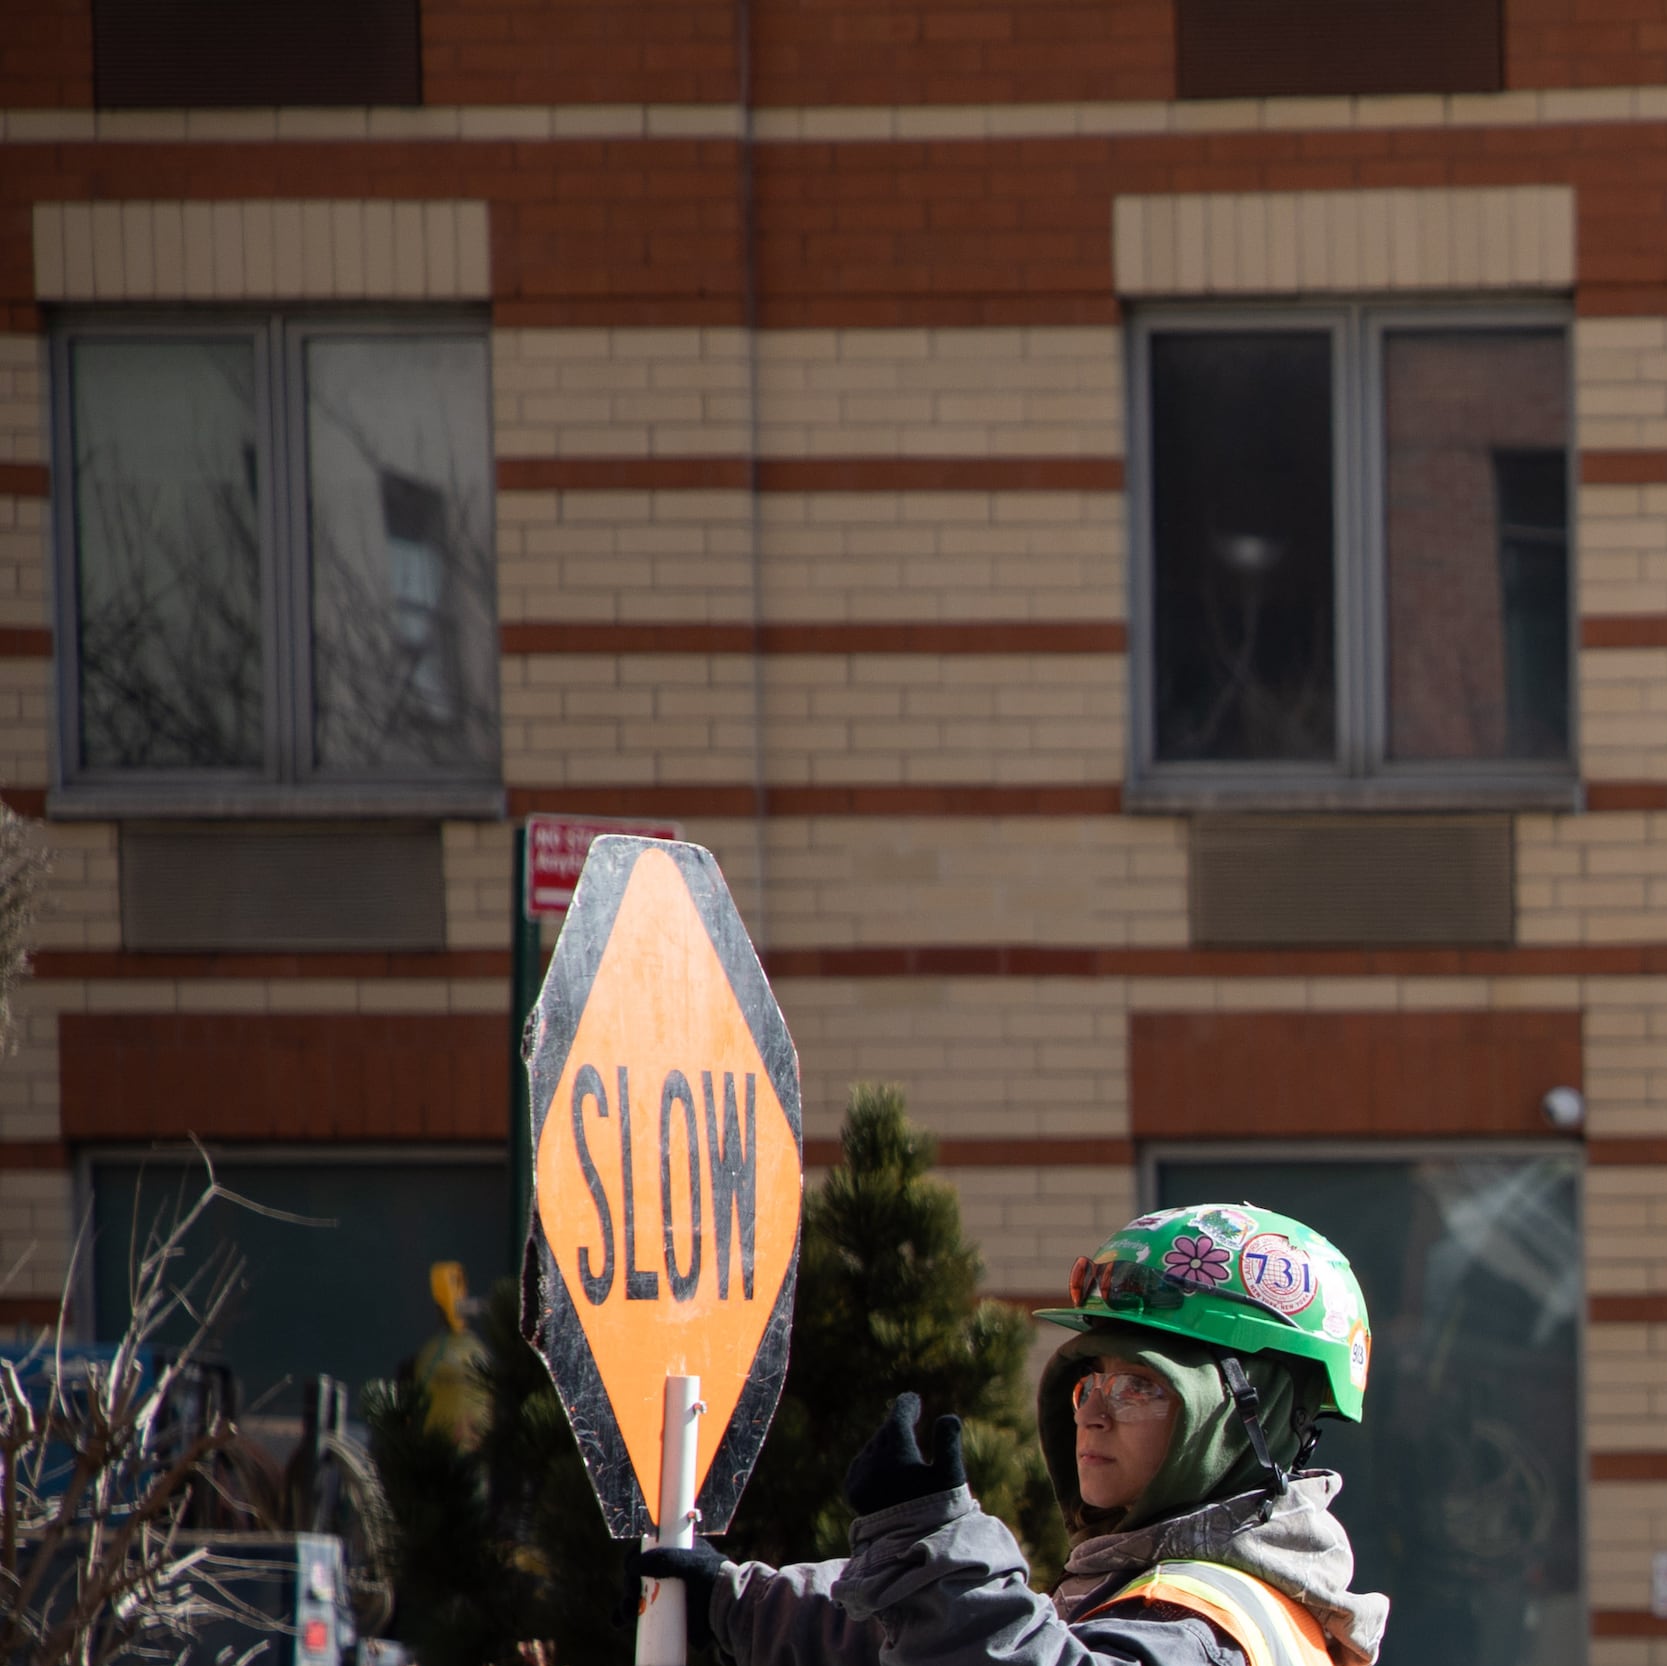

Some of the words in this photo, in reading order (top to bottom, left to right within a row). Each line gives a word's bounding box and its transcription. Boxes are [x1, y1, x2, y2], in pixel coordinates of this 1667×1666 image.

[534, 826, 561, 848] NO
[571, 1063, 757, 1306] SLOW
[1245, 1252, 1310, 1293] 731
